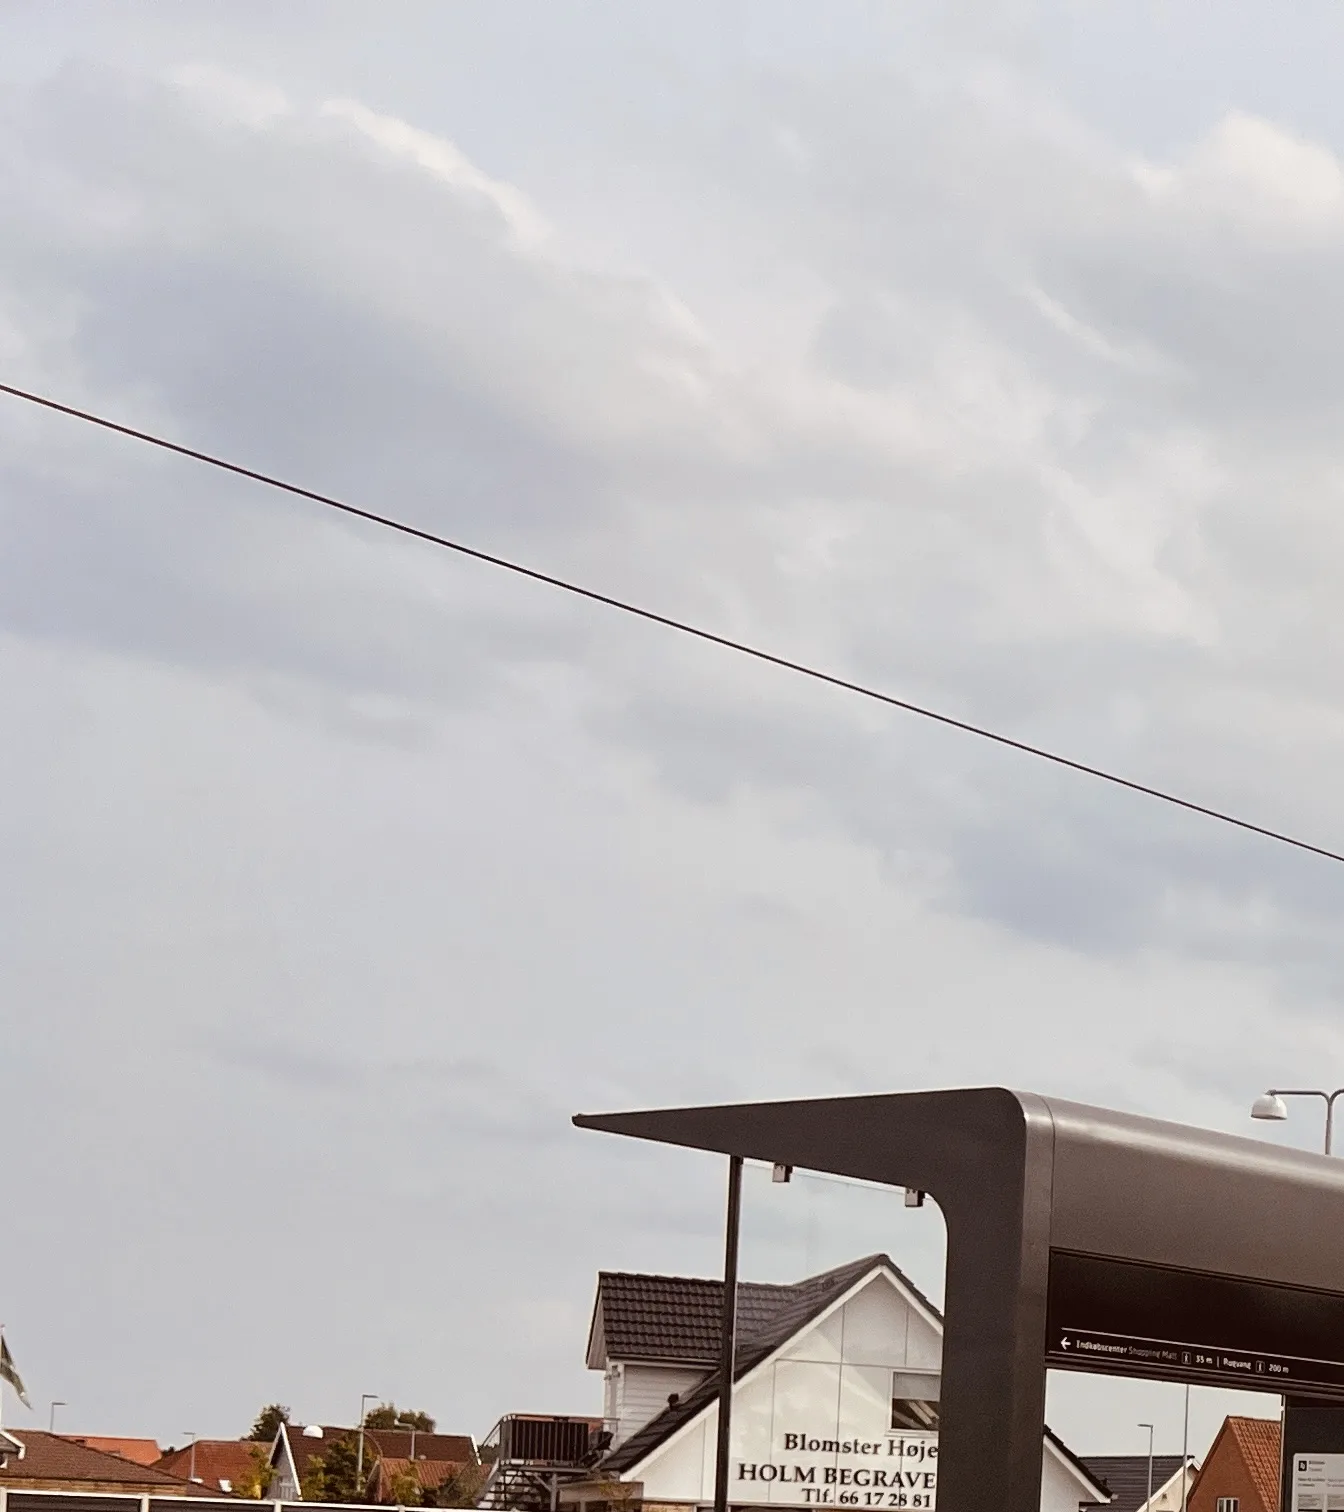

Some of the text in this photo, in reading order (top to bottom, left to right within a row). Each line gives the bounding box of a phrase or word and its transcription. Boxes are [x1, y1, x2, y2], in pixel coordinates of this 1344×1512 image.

[1268, 1363, 1282, 1373] 200
[784, 1432, 938, 1463] Blomster Høje
[738, 1463, 936, 1489] HOLM BEGRAVE
[801, 1487, 931, 1508] Tlf. 66 17 28 81
